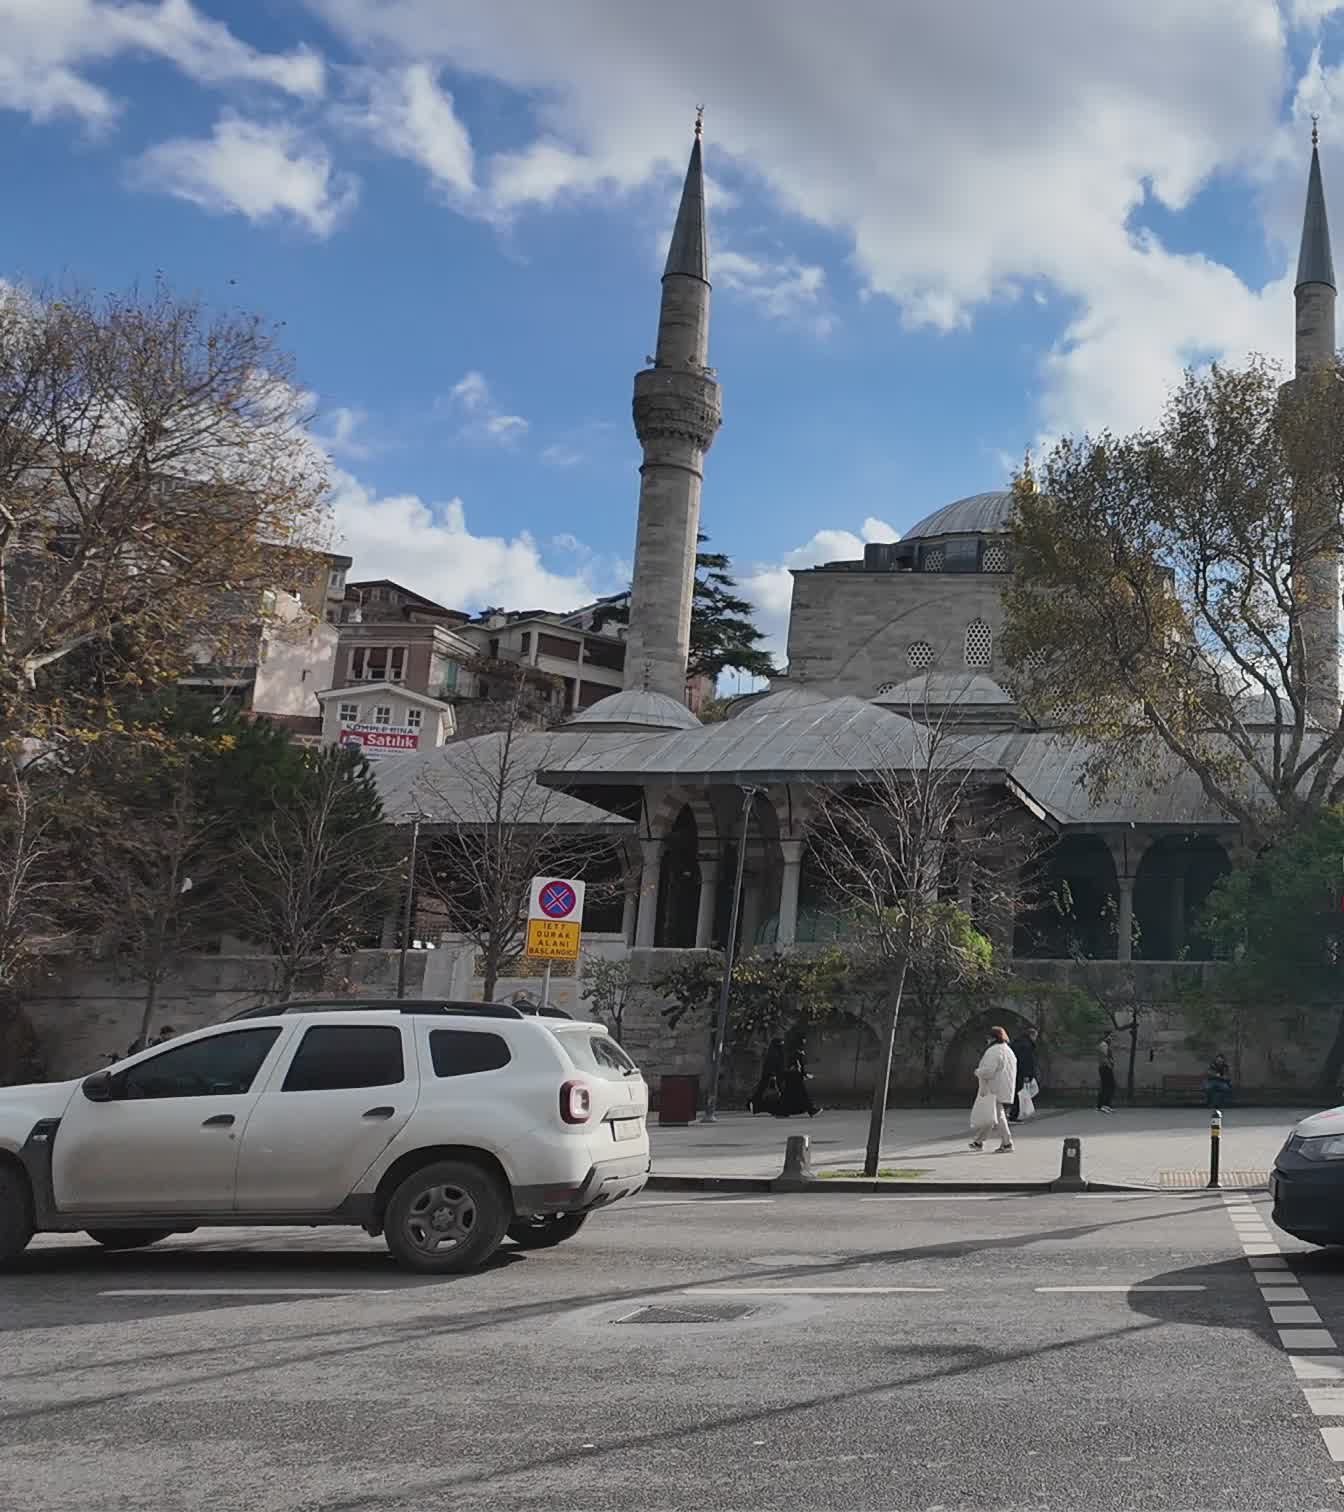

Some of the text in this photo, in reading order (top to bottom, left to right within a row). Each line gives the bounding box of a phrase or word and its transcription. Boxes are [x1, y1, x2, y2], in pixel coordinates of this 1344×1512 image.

[367, 734, 414, 748] Satılık
[537, 930, 570, 939] DURAK
[538, 940, 569, 948] ALANI
